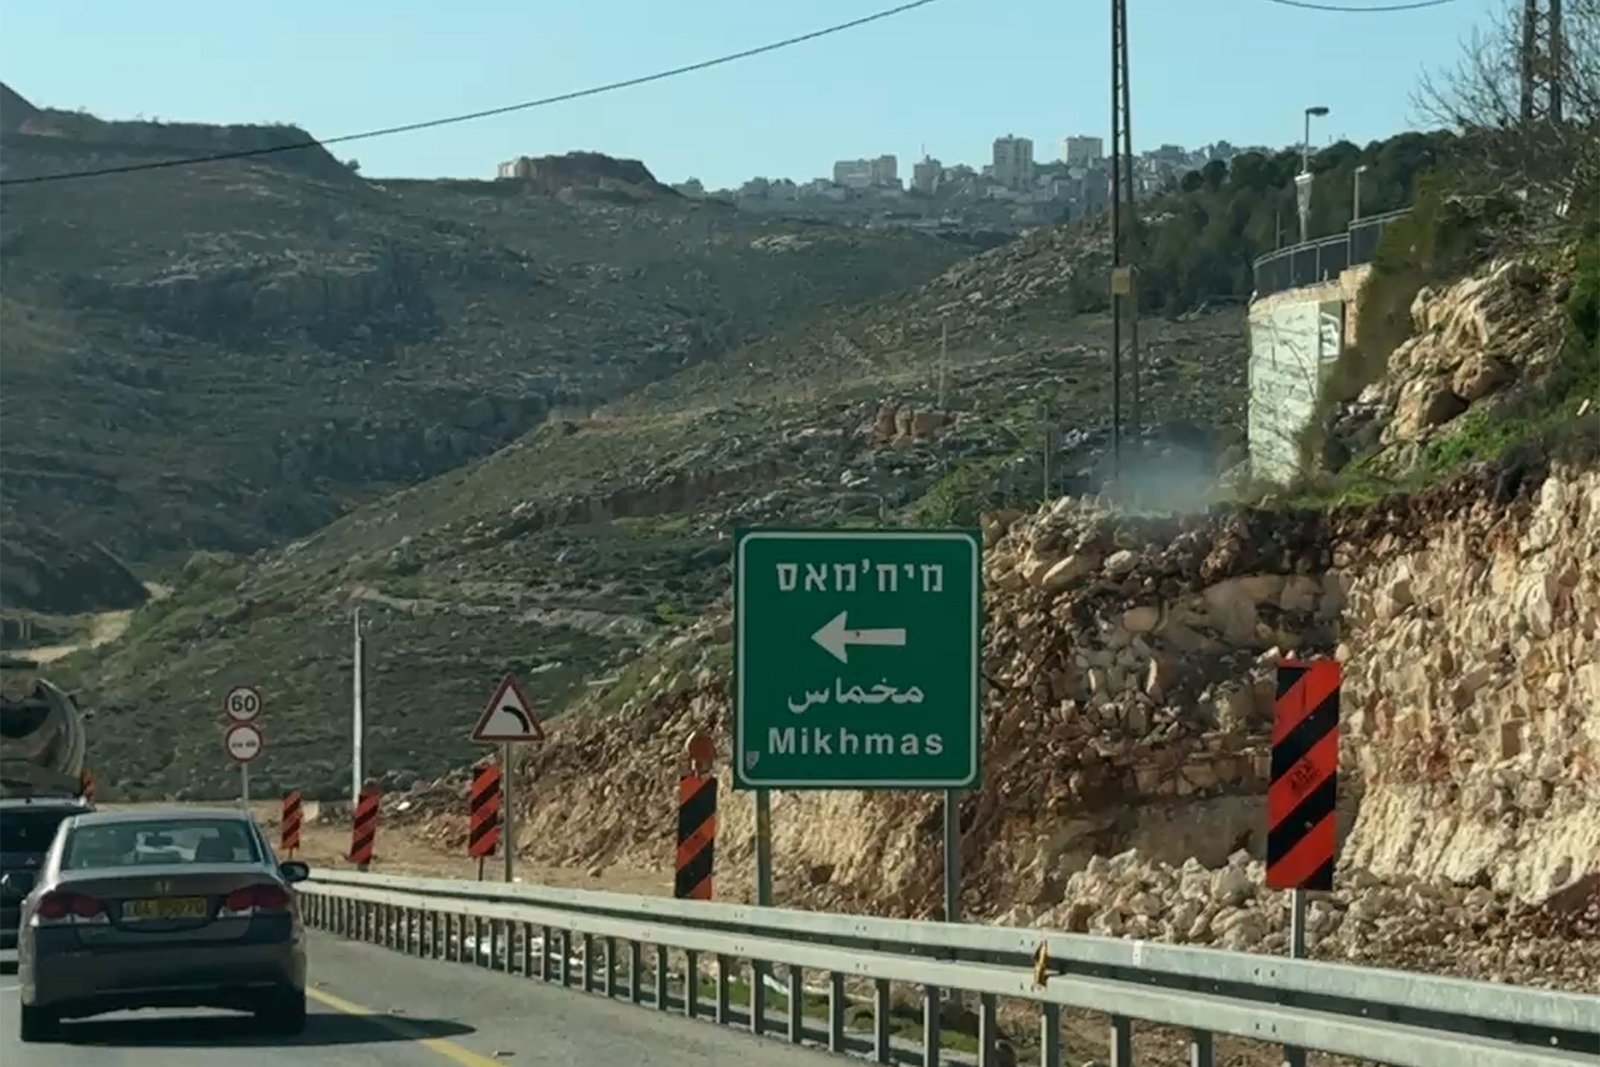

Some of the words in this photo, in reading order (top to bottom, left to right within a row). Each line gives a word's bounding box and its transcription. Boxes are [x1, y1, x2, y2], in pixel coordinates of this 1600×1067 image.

[231, 695, 256, 712] 60
[787, 676, 925, 714] مخماس
[768, 726, 944, 756] Mikhmas
